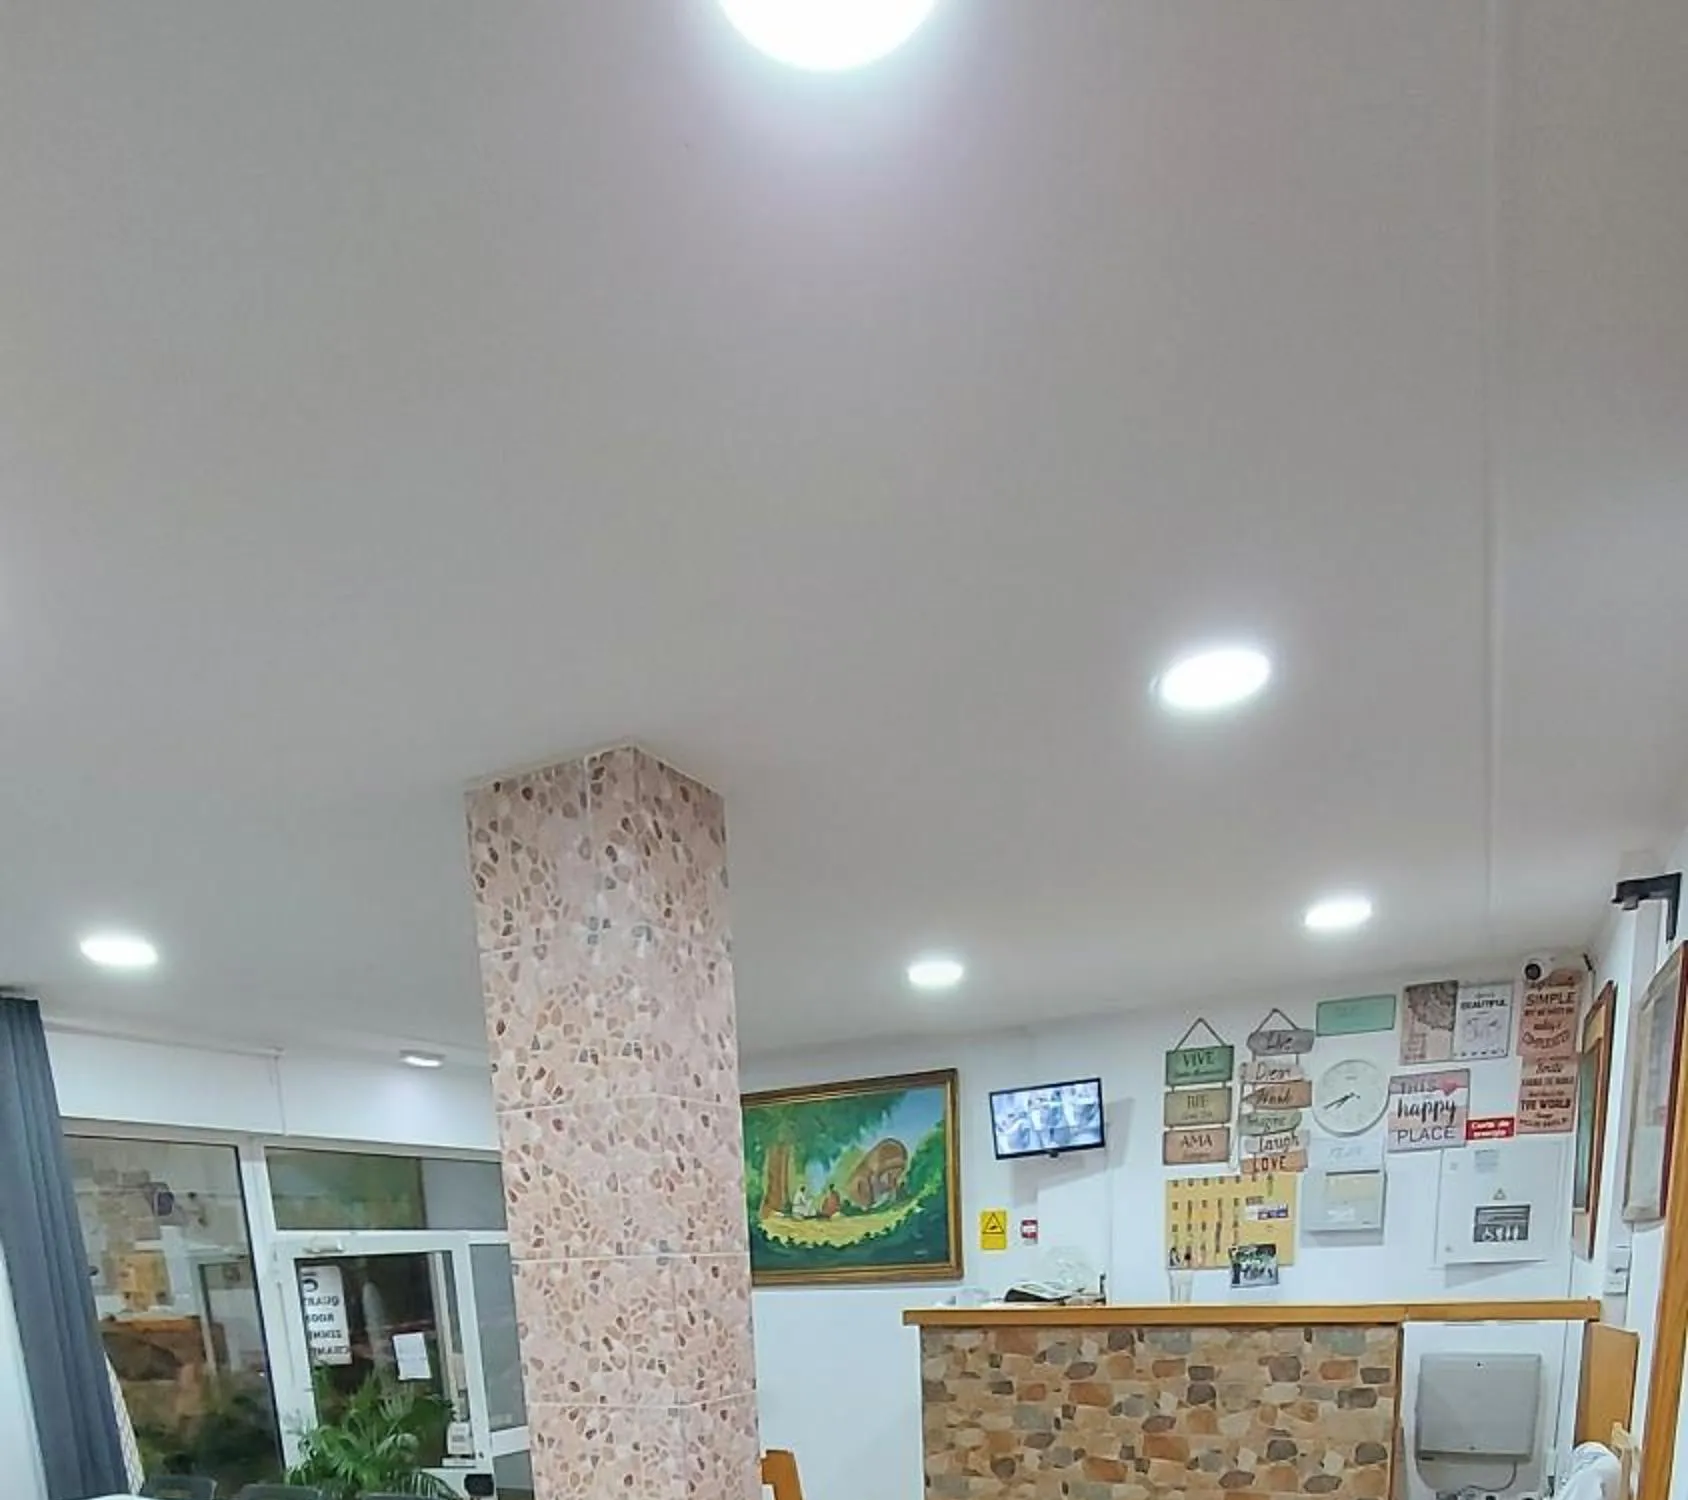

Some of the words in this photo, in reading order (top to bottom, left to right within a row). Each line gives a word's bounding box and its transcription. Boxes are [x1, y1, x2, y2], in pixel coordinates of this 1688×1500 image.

[1460, 999, 1509, 1010] BEAUTIFUL
[1525, 991, 1576, 1007] SIMPLE
[1183, 1051, 1215, 1068] VIVE
[1397, 1098, 1457, 1124] happy
[1181, 1134, 1213, 1149] AMA
[1397, 1126, 1456, 1145] PLACE
[1253, 1155, 1287, 1173] LOVE
